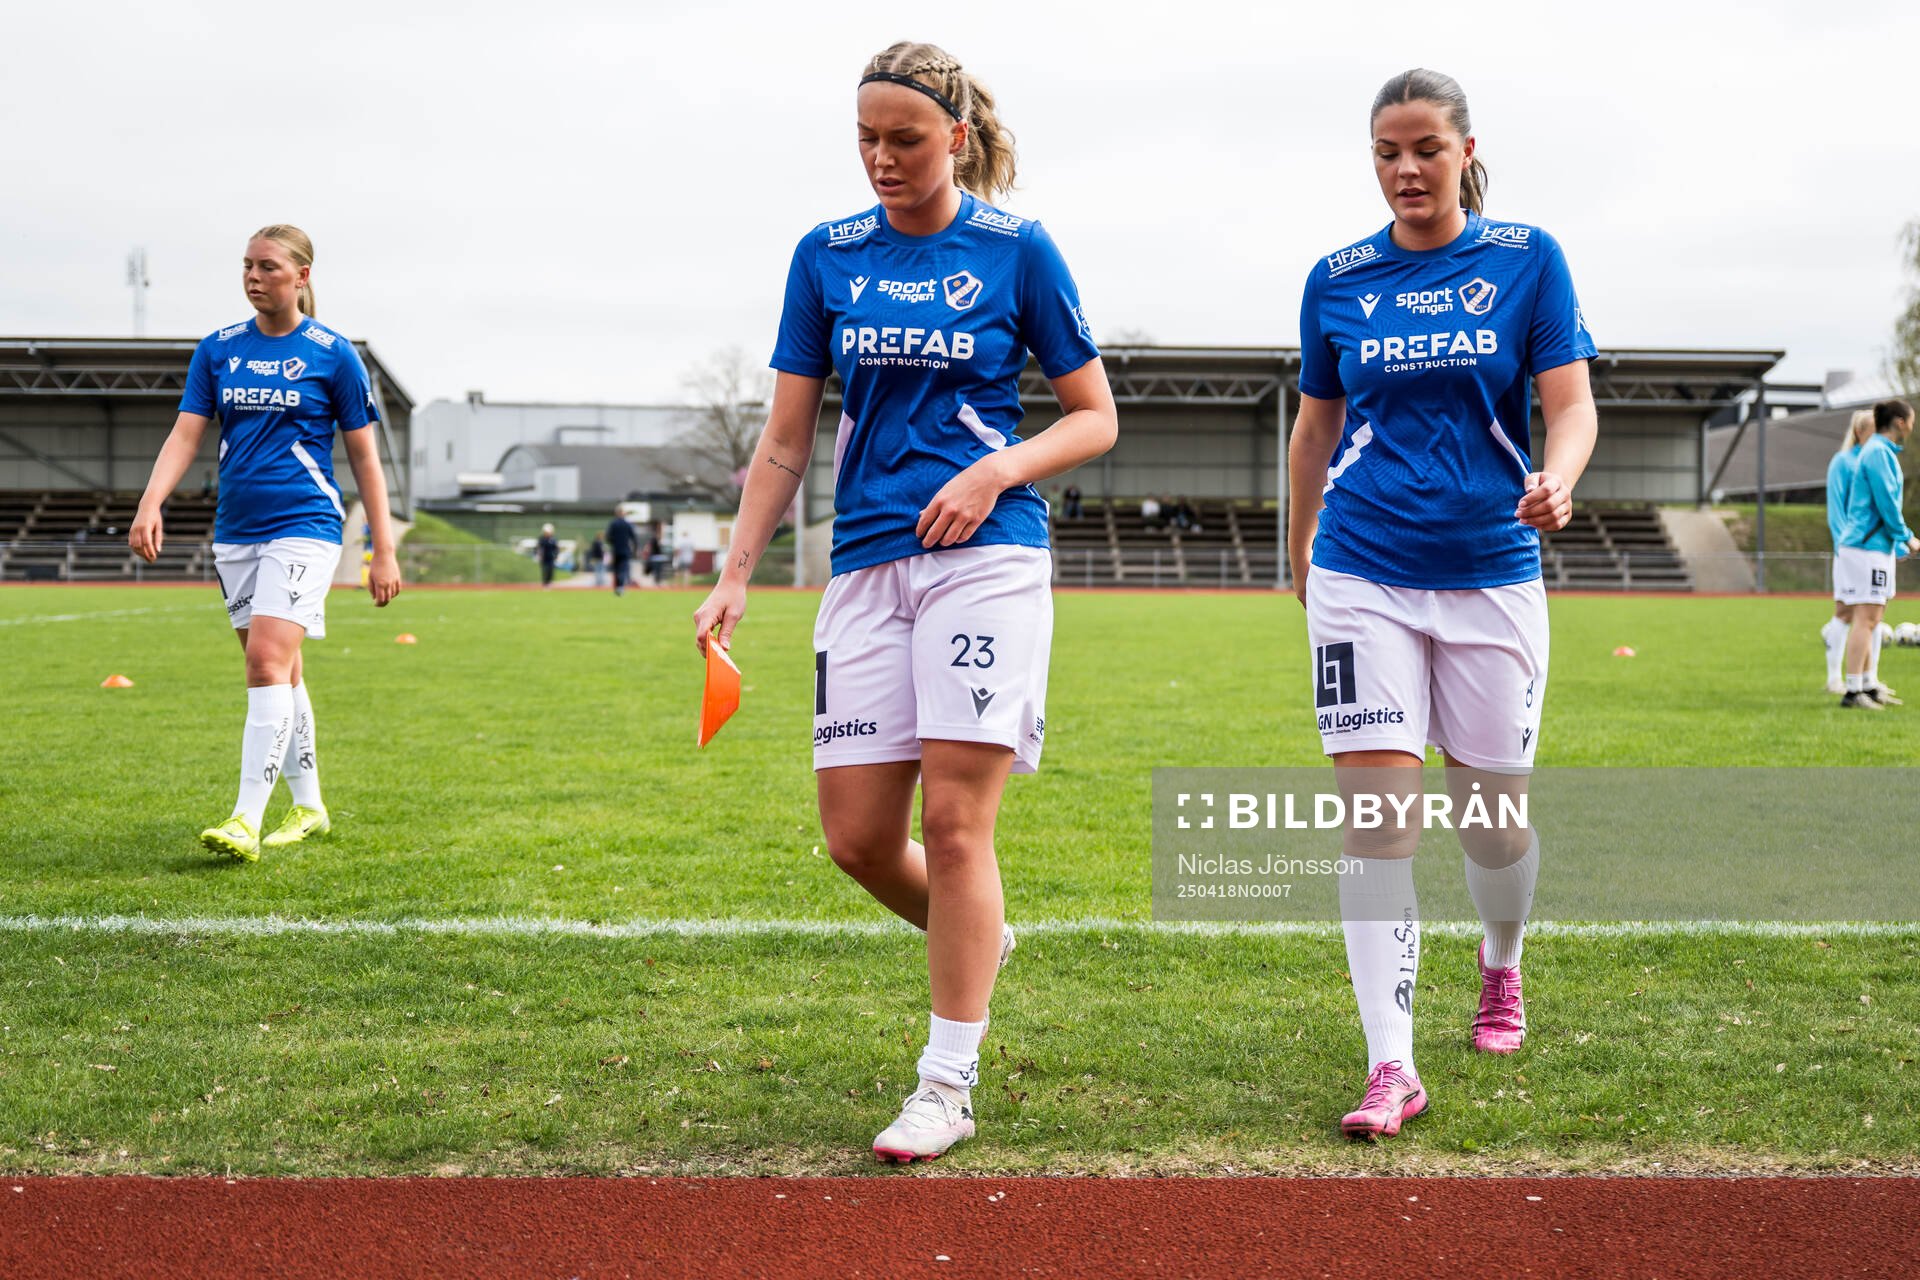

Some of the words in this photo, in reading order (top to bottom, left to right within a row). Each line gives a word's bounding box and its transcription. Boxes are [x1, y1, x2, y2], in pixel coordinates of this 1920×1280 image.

[829, 215, 876, 237] HFAB
[972, 208, 1023, 227] HFAB
[1482, 225, 1531, 240] HFAB
[1328, 244, 1376, 269] HFAB
[877, 278, 938, 296] sport
[891, 292, 935, 304] ringen
[1395, 287, 1454, 309] sport
[1411, 302, 1454, 316] ringen
[841, 326, 975, 360] PREFAB
[1360, 328, 1498, 364] PREFAB
[246, 359, 281, 372] sport
[858, 356, 950, 369] CONSTRUCTION
[1383, 357, 1477, 373] CONSTRUCTION
[222, 387, 301, 407] PREFAB
[234, 404, 286, 412] CONSTRUCTION
[288, 563, 307, 582] 17
[950, 633, 996, 669] 23
[1336, 707, 1404, 731] Logistics
[814, 718, 877, 744] ogistics
[1394, 906, 1416, 977] LinSon
